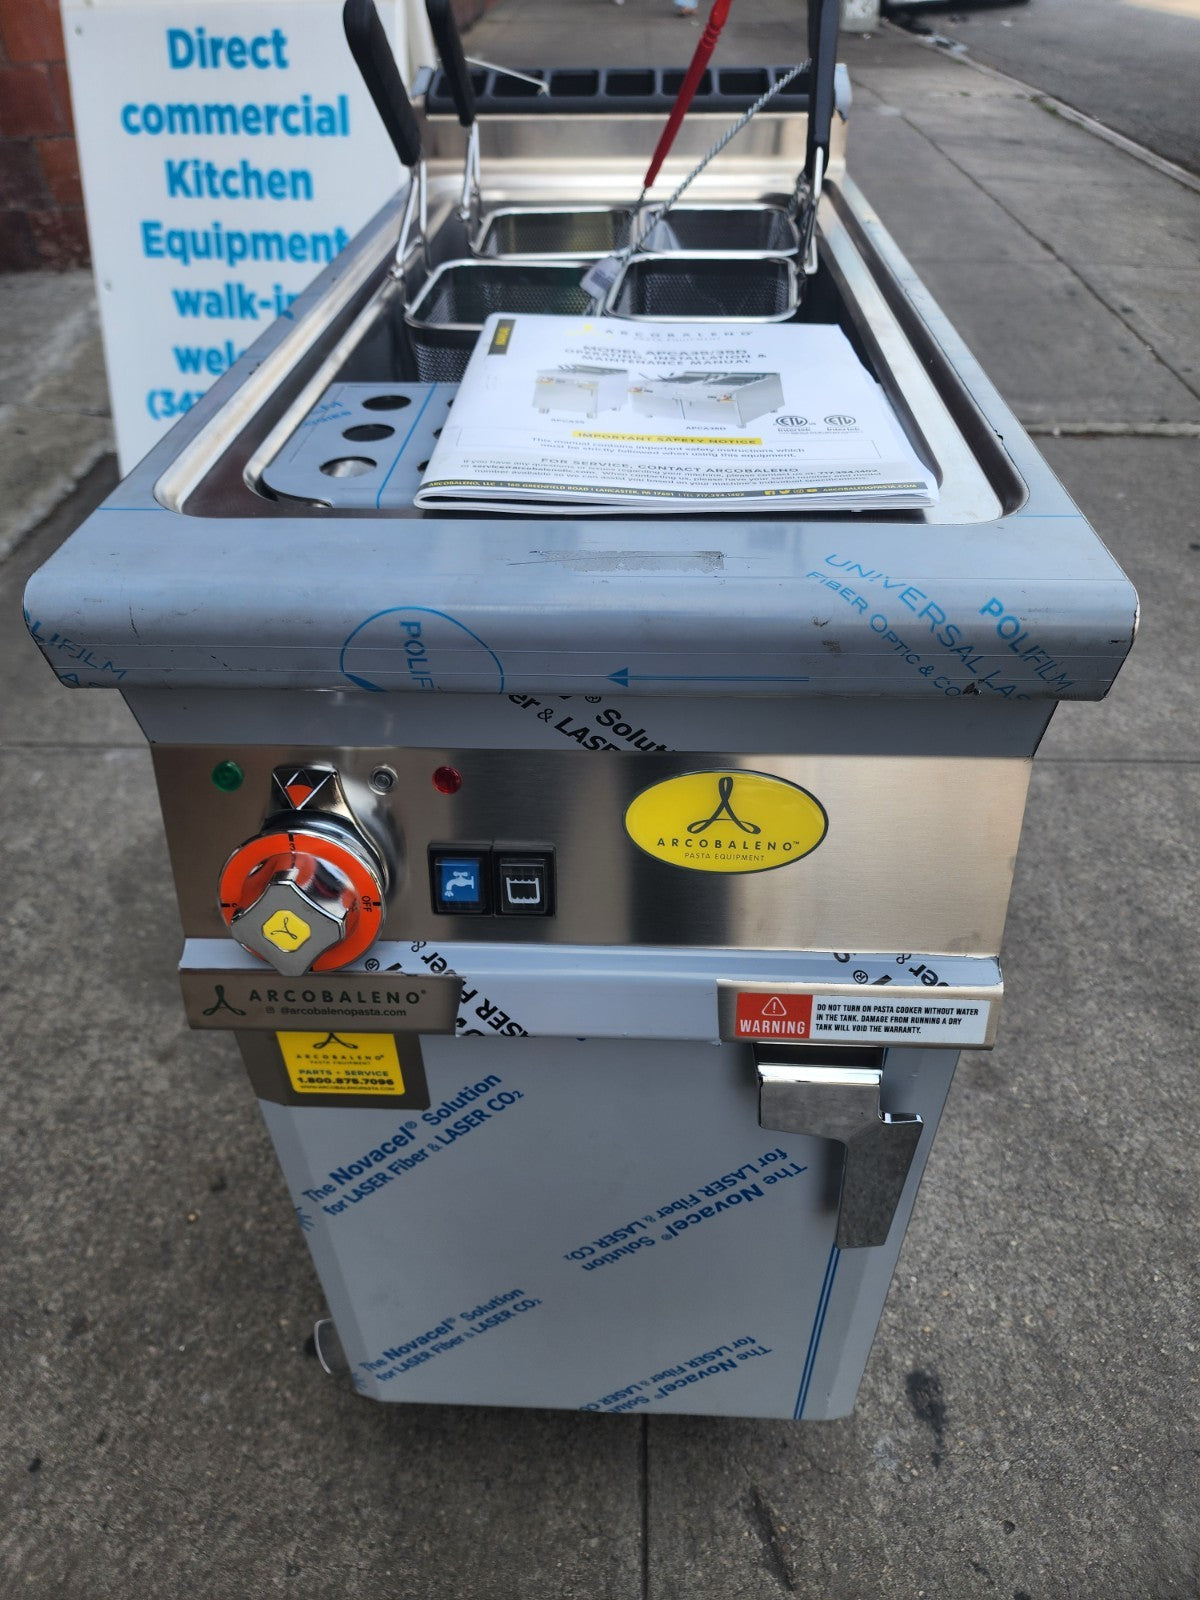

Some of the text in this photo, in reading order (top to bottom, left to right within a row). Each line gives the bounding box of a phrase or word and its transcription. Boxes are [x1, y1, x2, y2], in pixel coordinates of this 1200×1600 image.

[167, 27, 289, 70] Direct
[121, 94, 350, 137] commercial
[165, 159, 314, 200] Kitchen
[140, 221, 349, 267] Equipment
[173, 340, 247, 375] wel
[581, 355, 682, 365] MAINTENANCE
[582, 346, 636, 354] MODEL
[577, 432, 652, 442] IMPORTANT
[572, 460, 633, 469] SERVICE,
[636, 464, 701, 473] CONTACT
[595, 487, 641, 495] LANCASTER,
[806, 570, 869, 615] FIBER
[870, 613, 922, 665] OPTIC
[918, 664, 935, 677] &
[824, 553, 984, 674] UNIVERSAL
[978, 596, 1076, 692] POLIFILM
[537, 708, 554, 723] &
[595, 709, 677, 751] Solut
[289, 843, 296, 851] 3
[684, 851, 765, 862] PASTA EQUIPMENT
[361, 895, 372, 913] OFF
[280, 1006, 407, 1017] @arcobalenopasta.com
[474, 998, 530, 1037] SER
[816, 1003, 979, 1016] DO NOT TURN ON PASTA COOKER WITHOUT WATER
[816, 1013, 963, 1025] IN THE TANK. DAMAGE FROM RUNNING A DRY
[739, 1019, 806, 1035] WARNING
[815, 1023, 833, 1031] TANK
[852, 1024, 868, 1032] VOID
[883, 1025, 922, 1034] WARRANTY.
[298, 1068, 390, 1077] PARTS SERVICE
[434, 1108, 492, 1145] LASER
[302, 1182, 337, 1203] The
[421, 1074, 502, 1127] Solution
[426, 1135, 443, 1152] &
[387, 1147, 430, 1176] Fiber
[756, 1147, 789, 1168] for
[696, 1162, 761, 1198] LASER
[761, 1162, 809, 1186] The
[344, 1171, 395, 1205] LASER
[322, 1199, 348, 1217] for
[655, 1193, 702, 1219] Fiber
[644, 1214, 658, 1224] &
[592, 1220, 647, 1249] LASER
[581, 1235, 656, 1272] Solution
[358, 1357, 388, 1373] The
[459, 1287, 525, 1323] Solution
[375, 1369, 397, 1382] for
[393, 1350, 434, 1374] LASER
[430, 1335, 465, 1354] Fiber
[463, 1331, 475, 1339] &
[469, 1309, 516, 1334] LASER
[731, 1335, 757, 1350] for
[735, 1345, 774, 1362] The
[683, 1344, 733, 1369] LASER
[639, 1380, 651, 1388] &
[649, 1365, 688, 1384] Fiber
[597, 1383, 643, 1406] LASER
